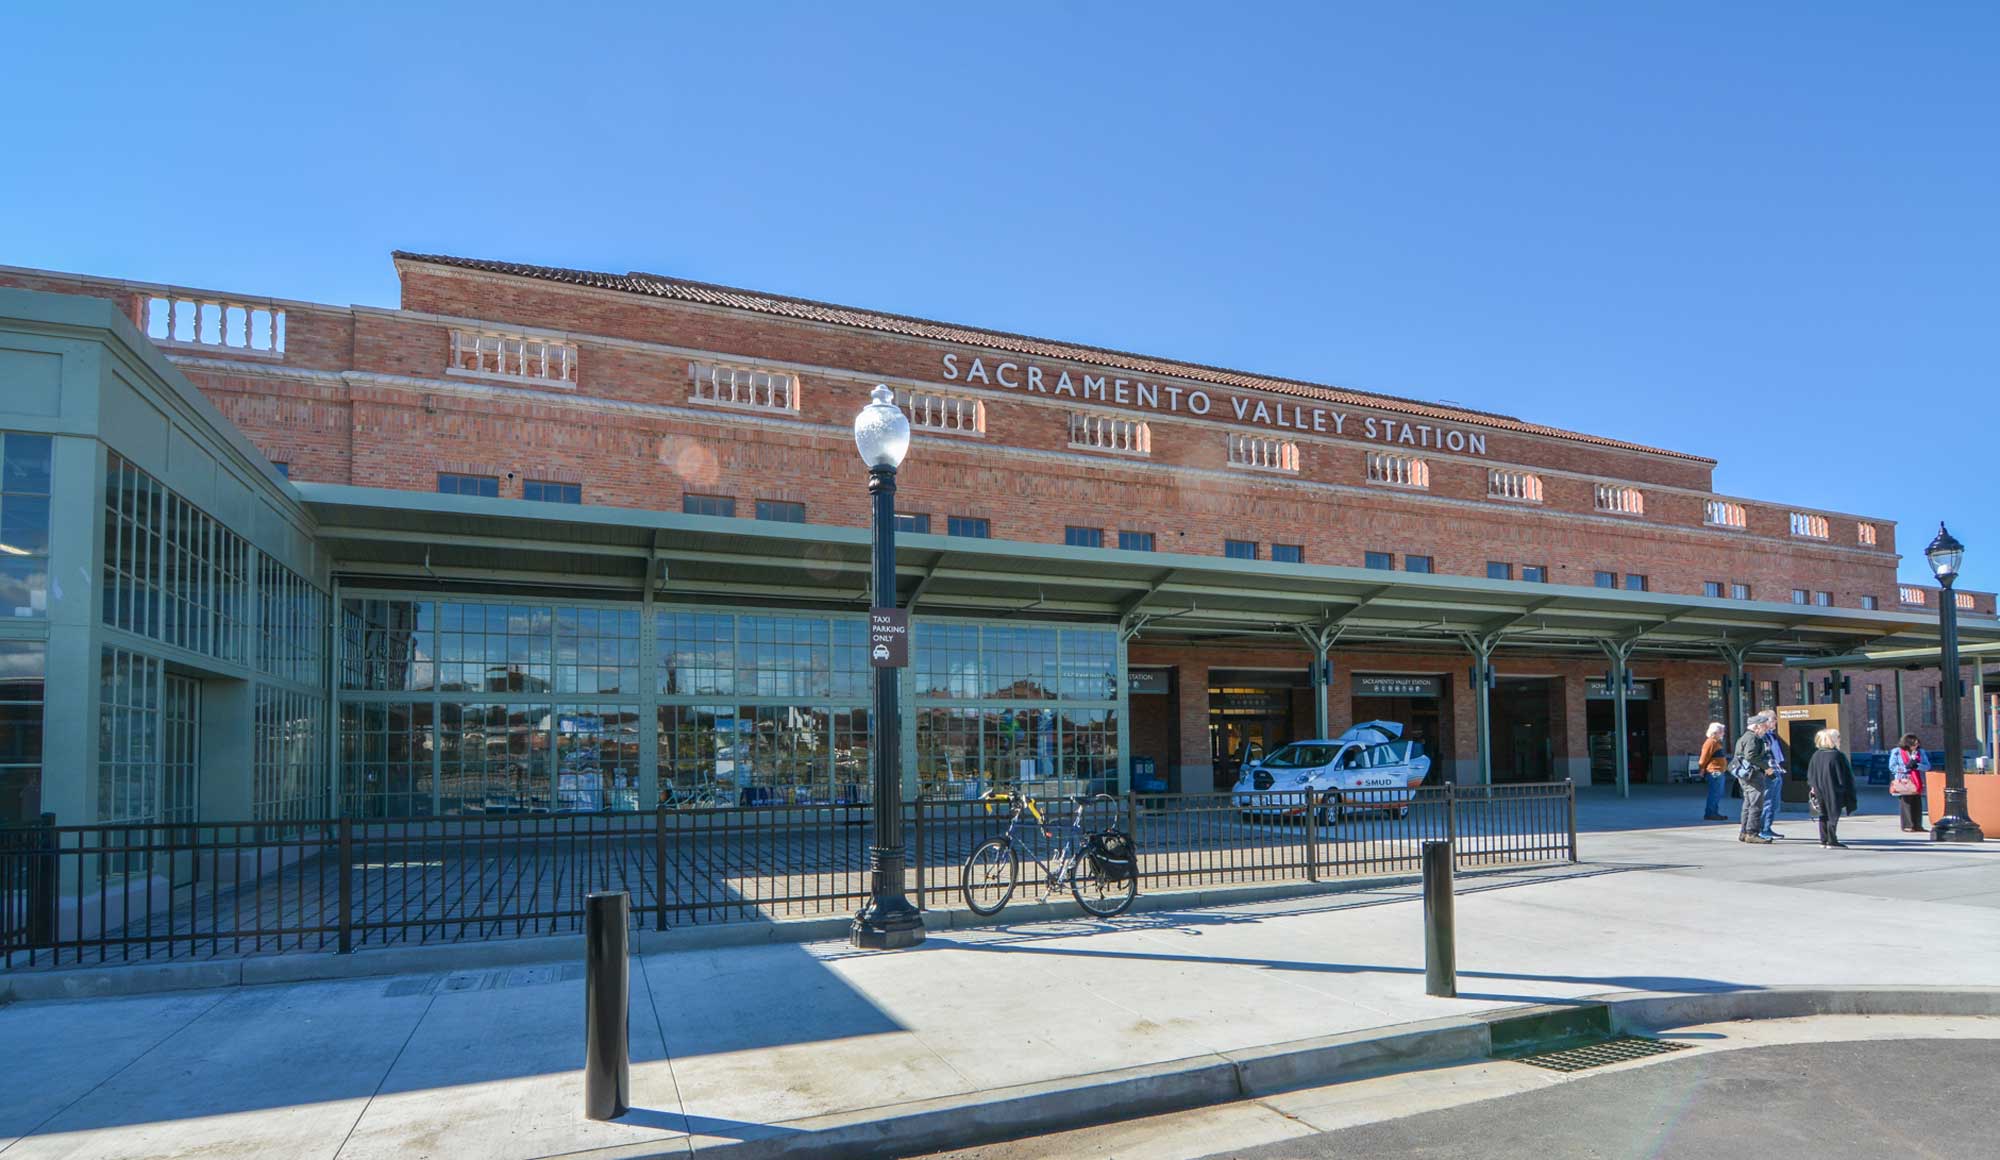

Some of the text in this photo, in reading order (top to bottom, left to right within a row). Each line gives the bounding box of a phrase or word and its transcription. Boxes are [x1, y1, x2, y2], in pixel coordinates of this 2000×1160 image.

[942, 353, 1487, 455] SACRAMENTO VALLEY STATION
[872, 616, 890, 624] TAXI
[872, 625, 905, 633] PARKING
